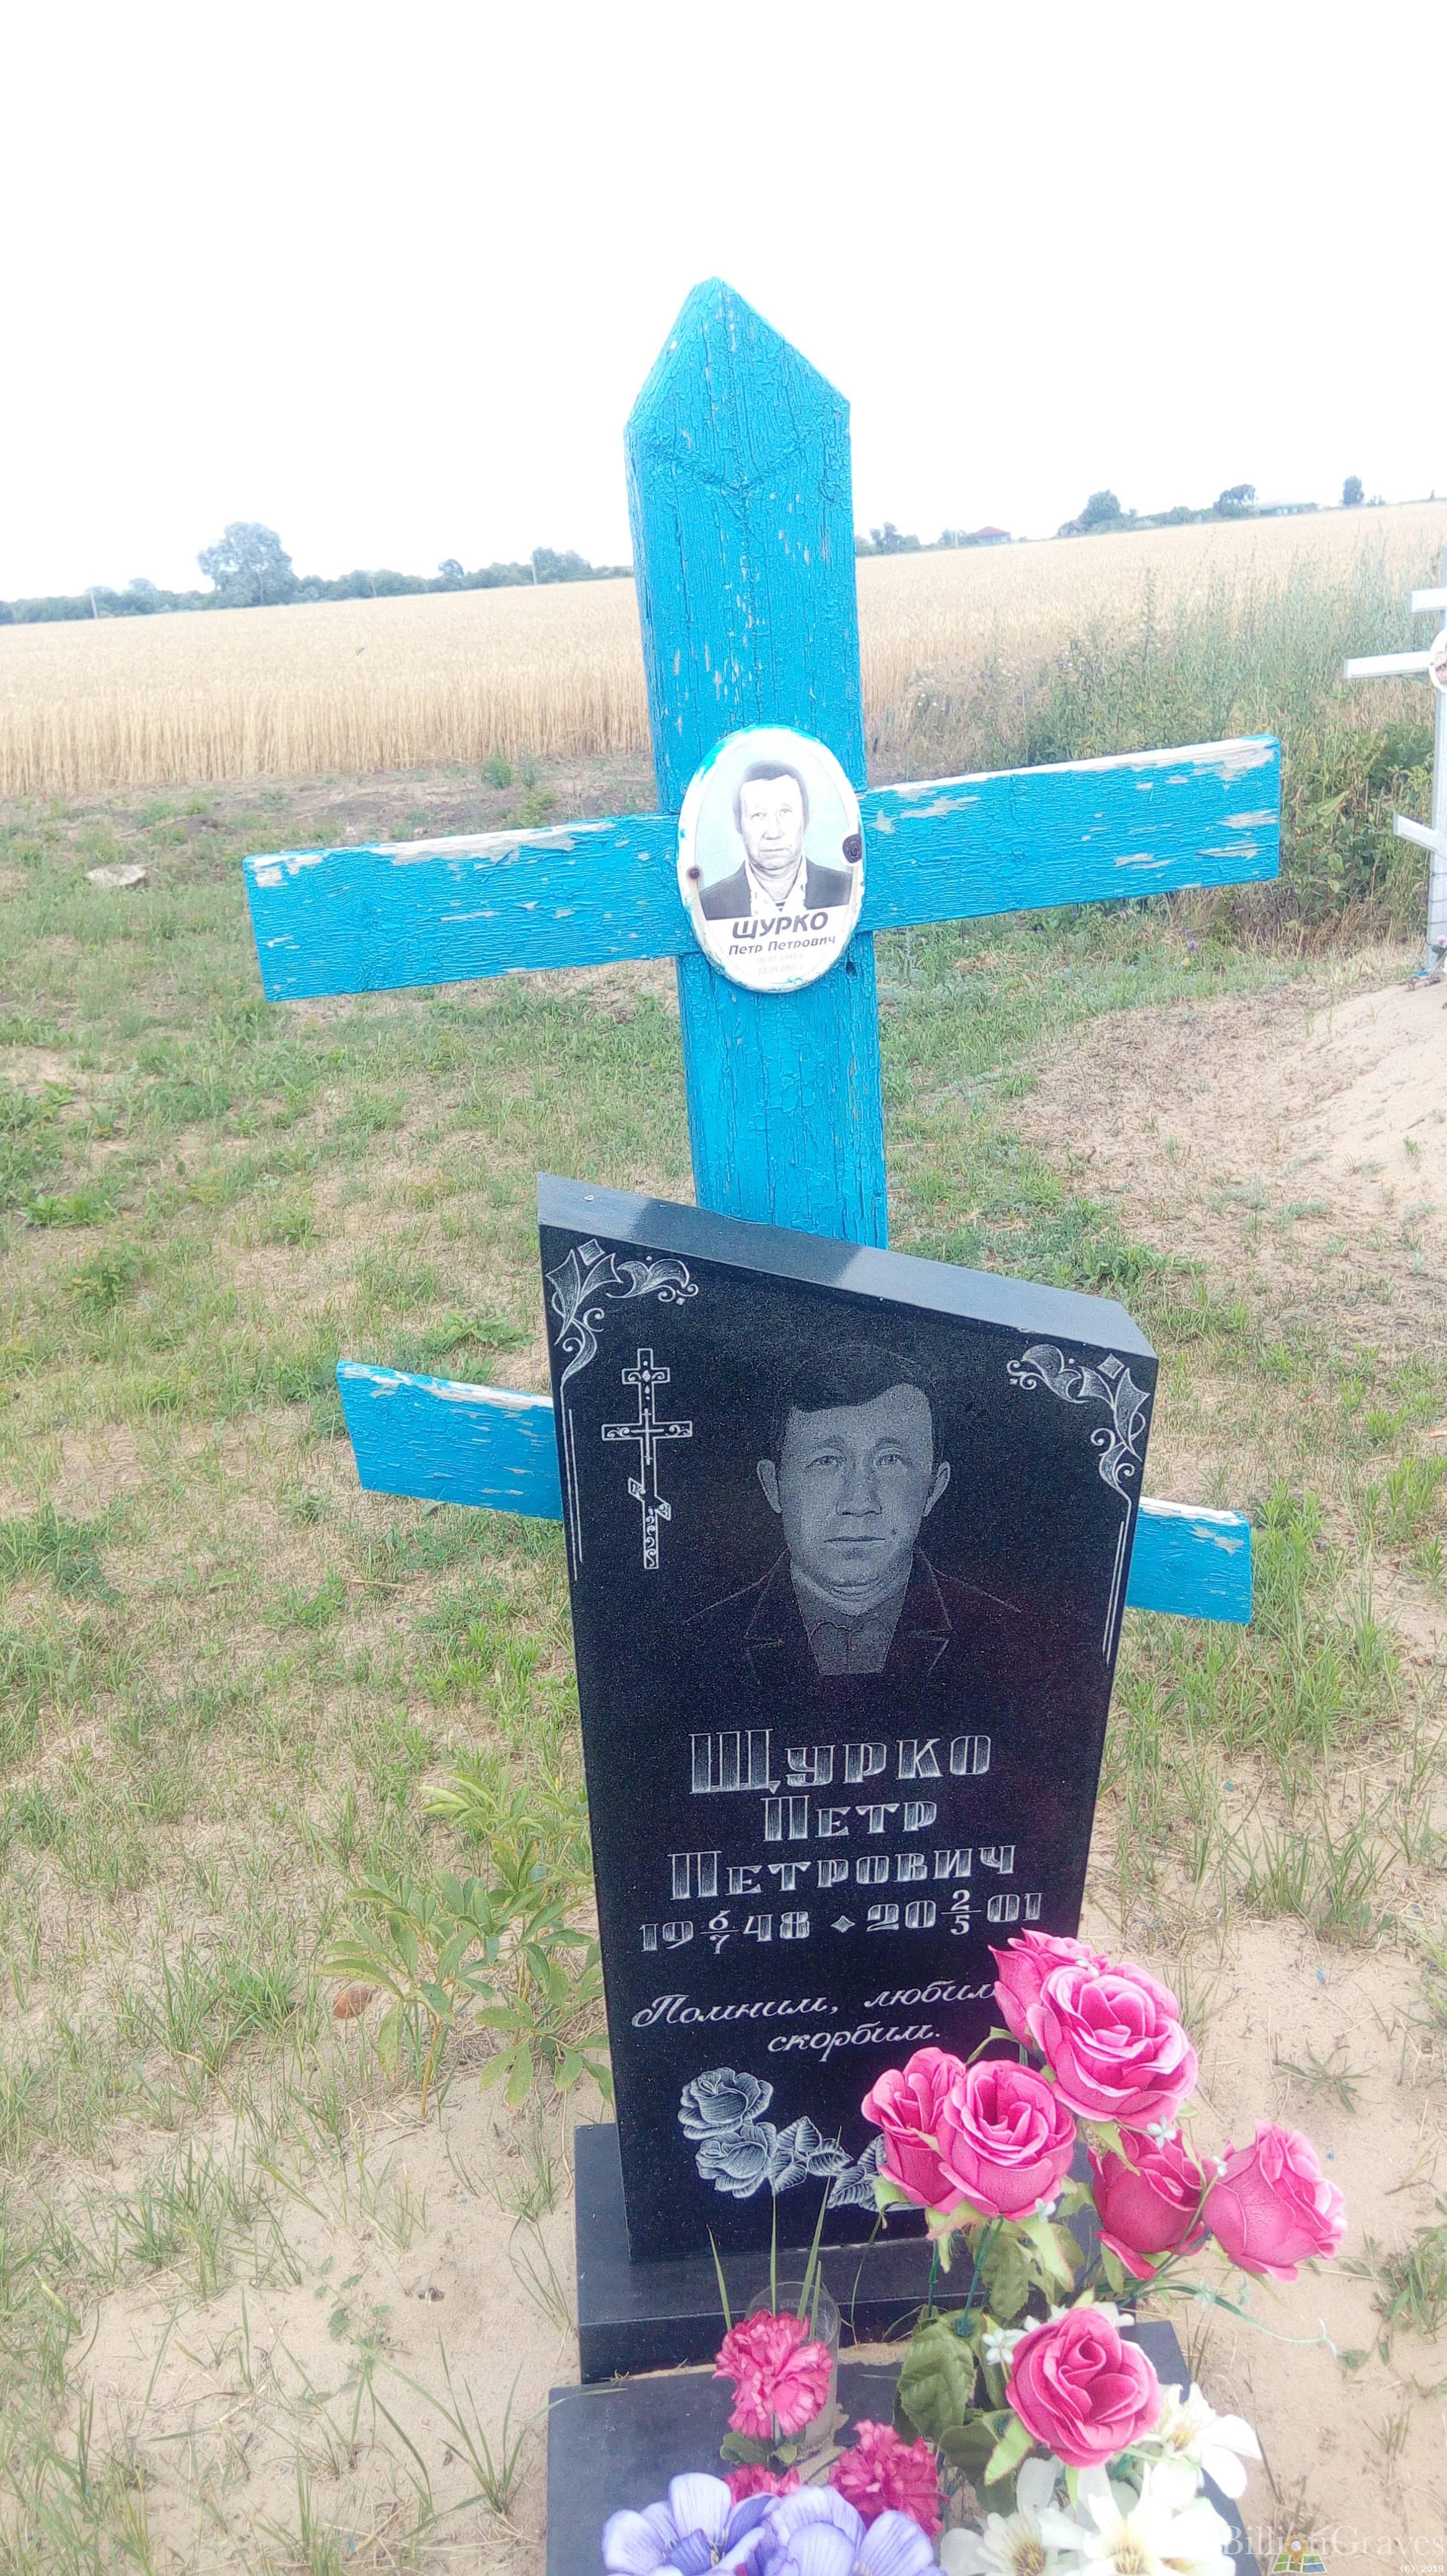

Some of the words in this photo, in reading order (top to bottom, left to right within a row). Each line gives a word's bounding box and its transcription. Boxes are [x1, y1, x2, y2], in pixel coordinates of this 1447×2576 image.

[728, 944, 763, 955] Петр
[767, 935, 836, 952] Петрович
[732, 912, 829, 939] ЩУРКО
[688, 1728, 992, 1795] ЩУРКО
[760, 1795, 937, 1842] ПЕТР
[667, 1845, 1016, 1900] ПЕТРОВИЧ
[631, 1993, 839, 2027] Помним,
[767, 2014, 940, 2062] скорбим.
